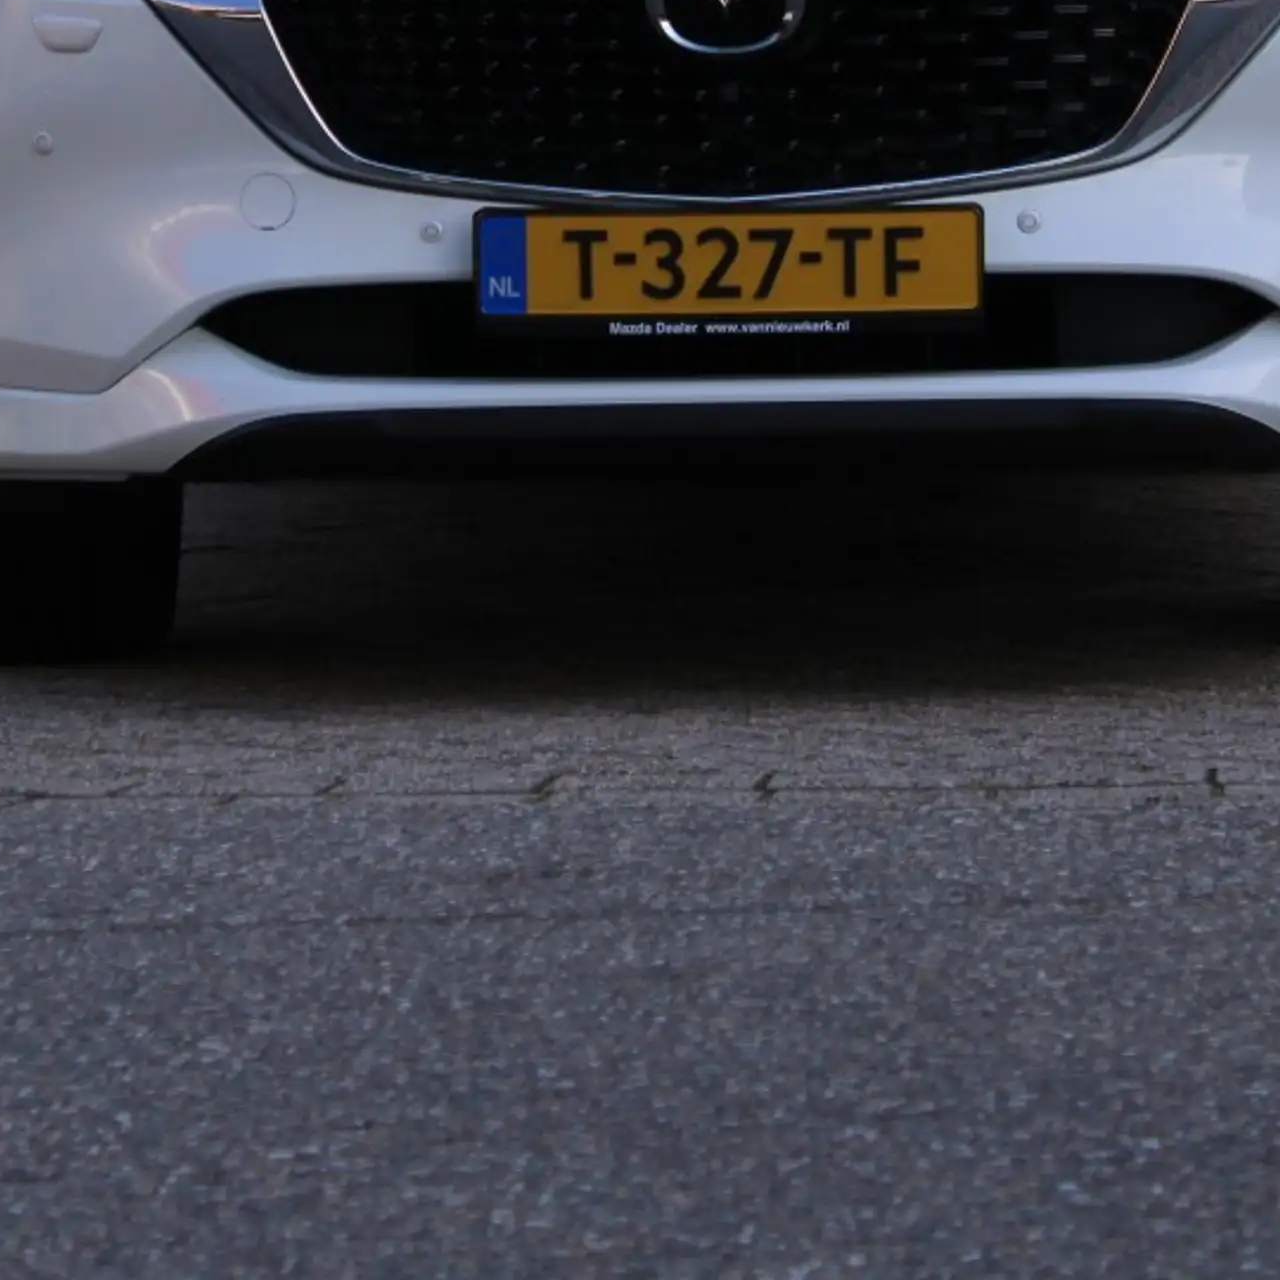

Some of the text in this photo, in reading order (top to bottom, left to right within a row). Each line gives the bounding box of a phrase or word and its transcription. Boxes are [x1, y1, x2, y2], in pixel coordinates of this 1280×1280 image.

[562, 227, 925, 300] T-327-TF
[489, 275, 520, 298] NL
[608, 320, 850, 335] Mazda Dealer www.vannieuwkerk.nl
